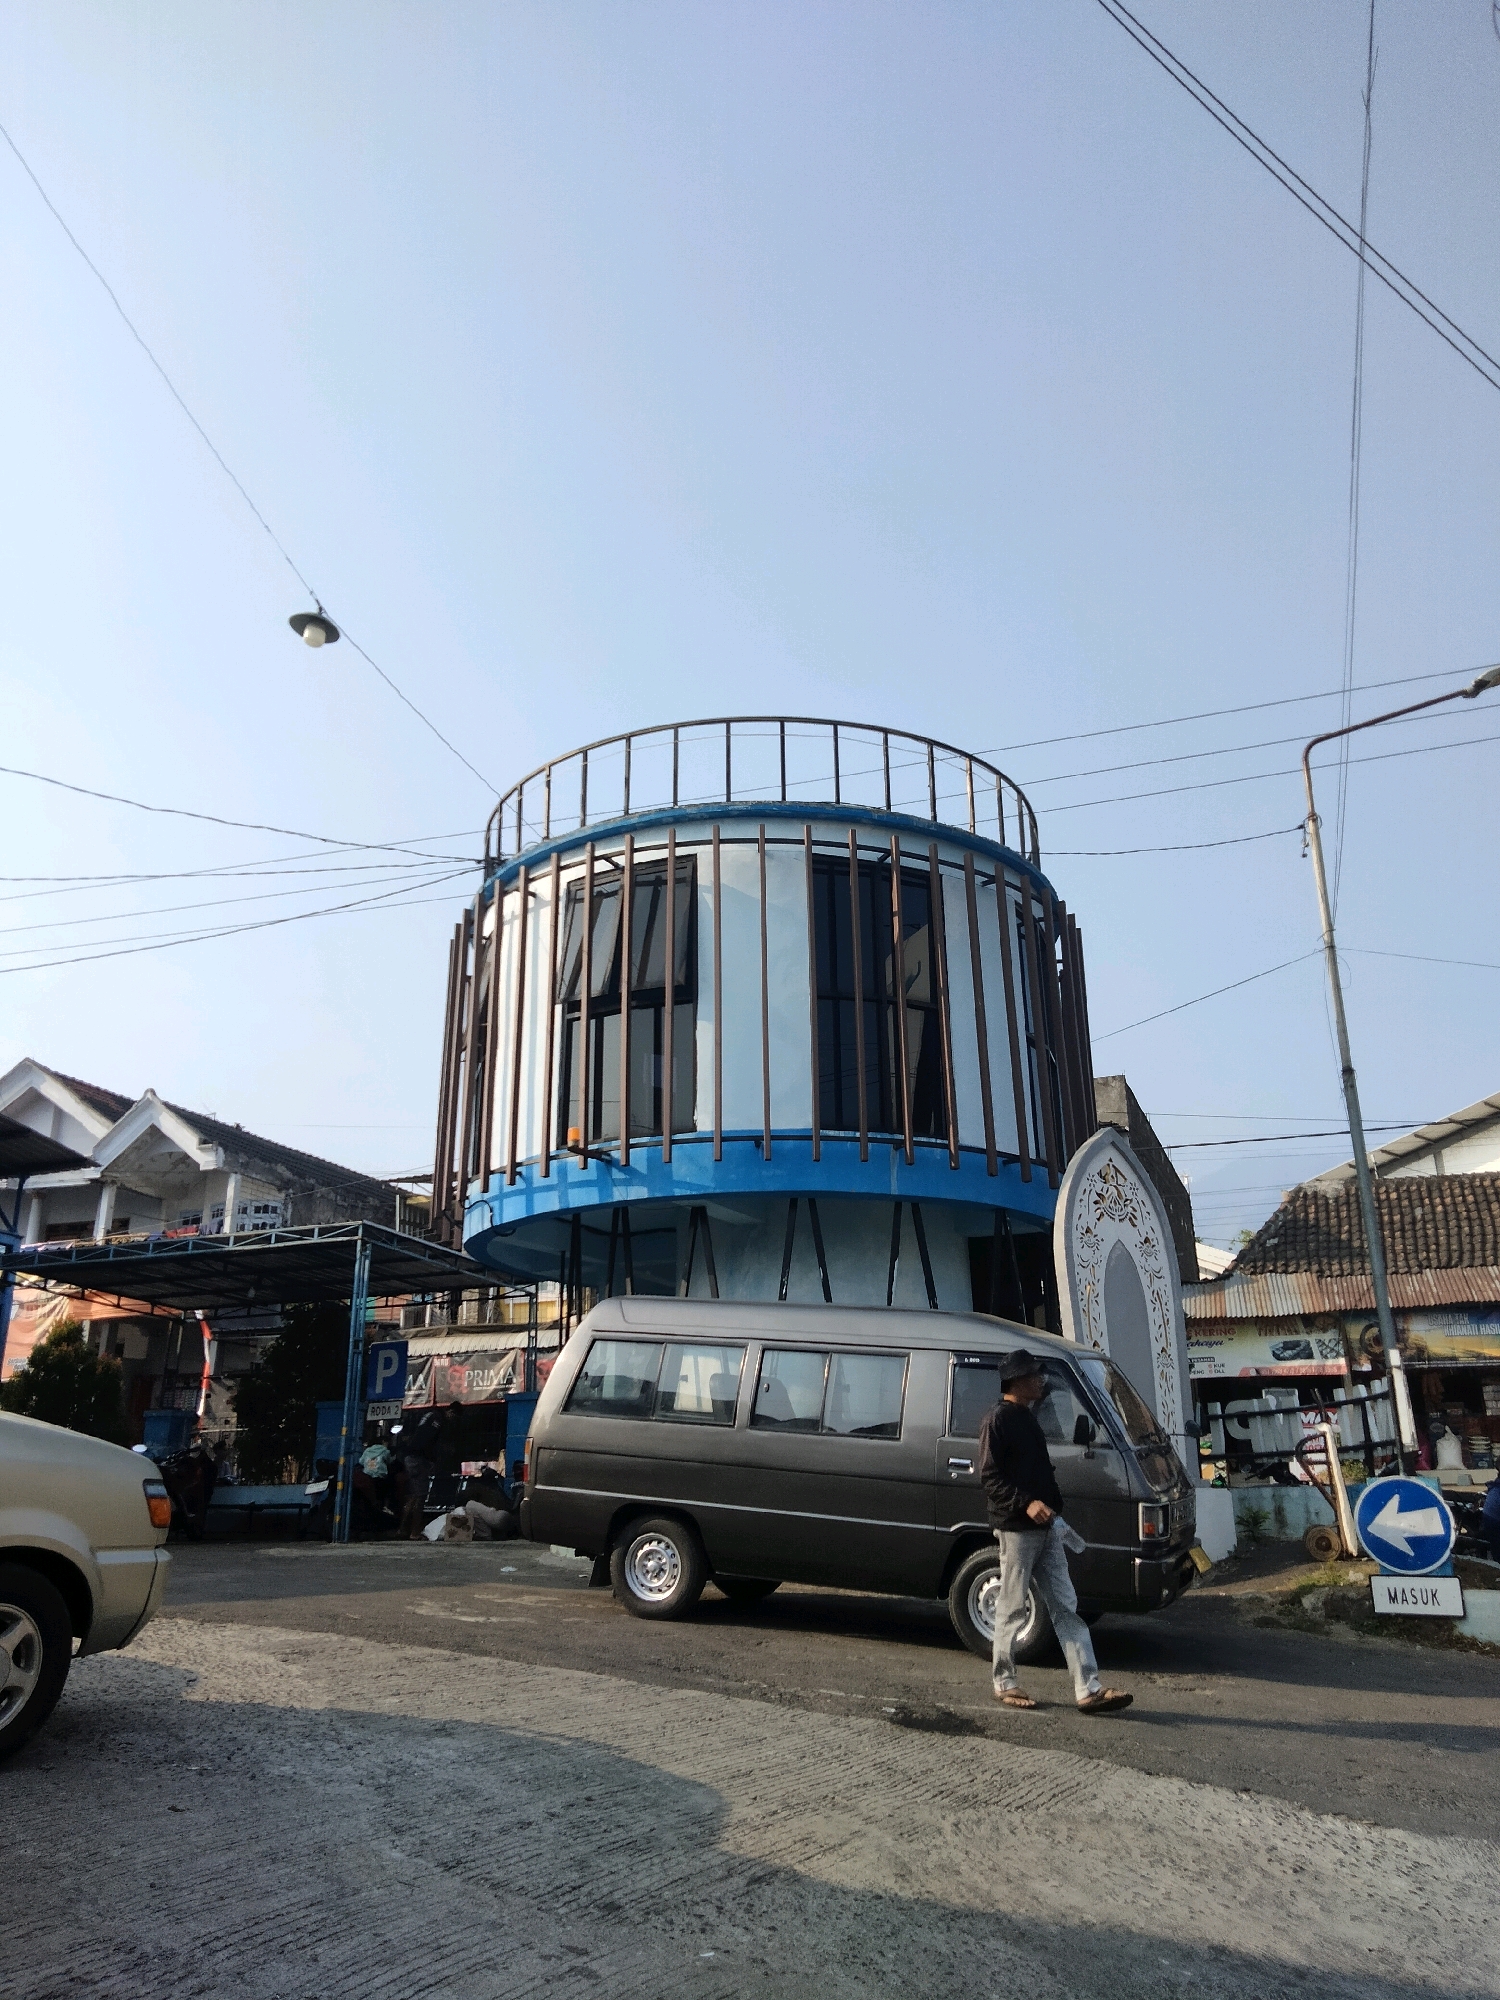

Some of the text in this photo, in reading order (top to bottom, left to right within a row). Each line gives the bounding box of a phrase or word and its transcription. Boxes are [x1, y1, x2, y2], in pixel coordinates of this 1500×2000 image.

[1194, 1328, 1237, 1336] KERING
[1444, 1324, 1478, 1336] KHIANATI
[1187, 1339, 1224, 1348] ahayu
[375, 1349, 399, 1394] P
[464, 1367, 516, 1387] PRIMA
[370, 1405, 399, 1417] RODA 2
[1387, 1586, 1441, 1607] MASUK
